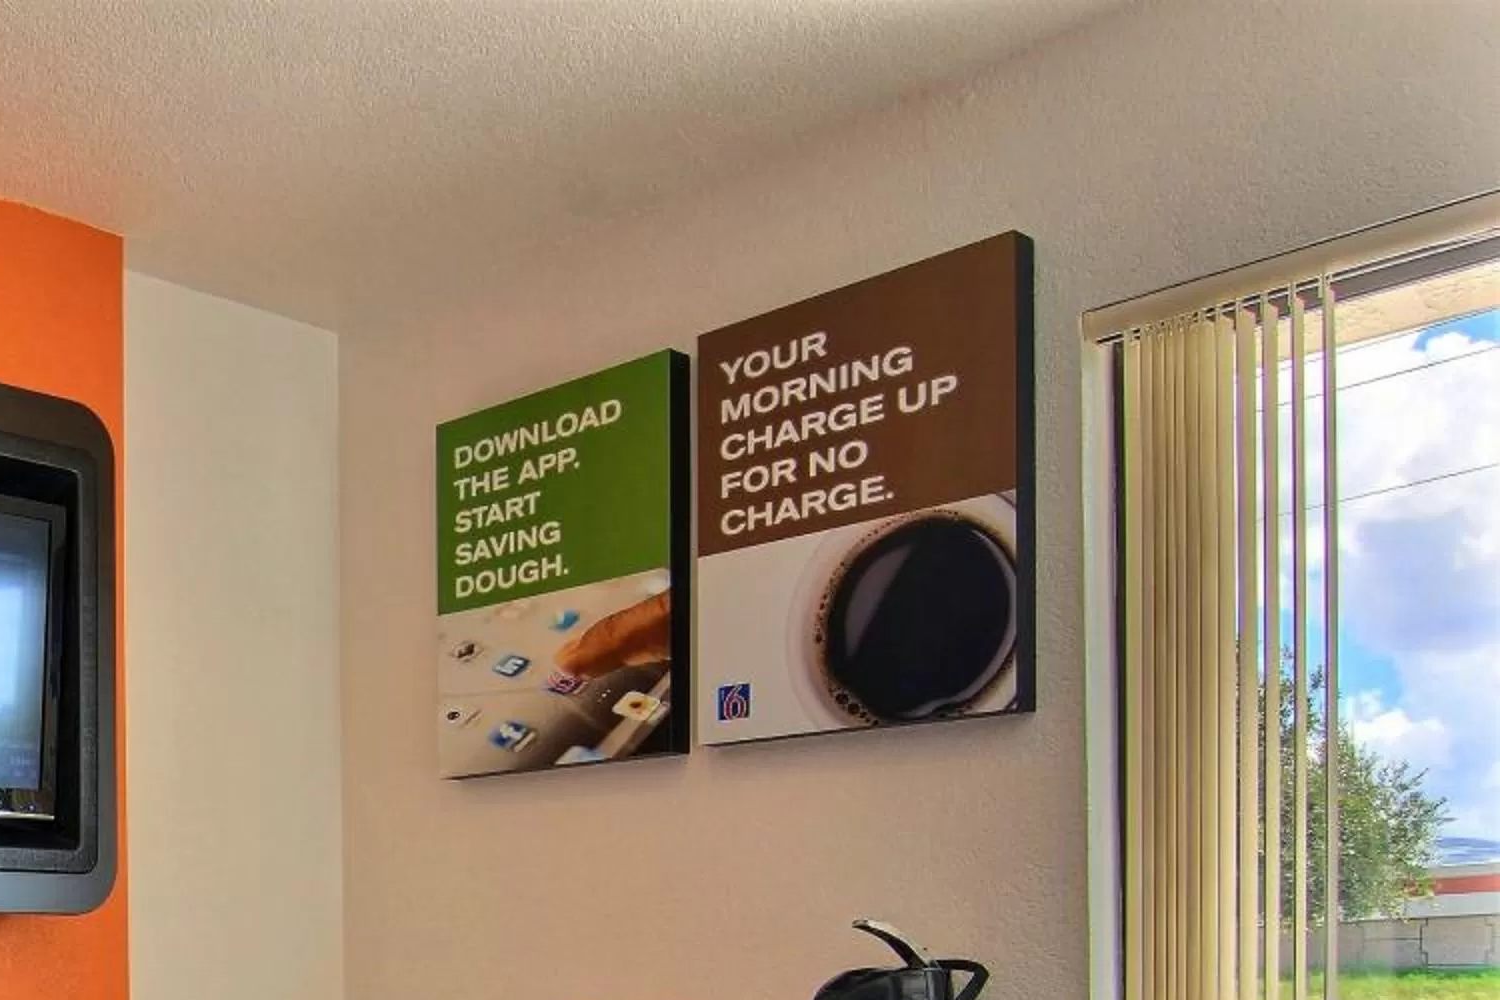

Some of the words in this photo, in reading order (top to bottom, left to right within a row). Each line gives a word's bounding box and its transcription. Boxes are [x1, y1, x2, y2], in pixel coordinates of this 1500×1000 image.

[720, 330, 828, 386] YOUR
[720, 346, 914, 425] MORNING
[453, 399, 622, 470] DOWNLOAD
[720, 393, 886, 462] CHARGE
[896, 374, 958, 416] UP
[453, 467, 509, 501] THE
[518, 446, 581, 485] APP.
[720, 459, 797, 499] FOR
[808, 439, 868, 478] NO
[454, 491, 541, 534] START
[720, 474, 895, 536] CHARGE.
[454, 520, 561, 566] SAVING
[454, 554, 569, 599] DOUGH.
[723, 685, 747, 721] 6
